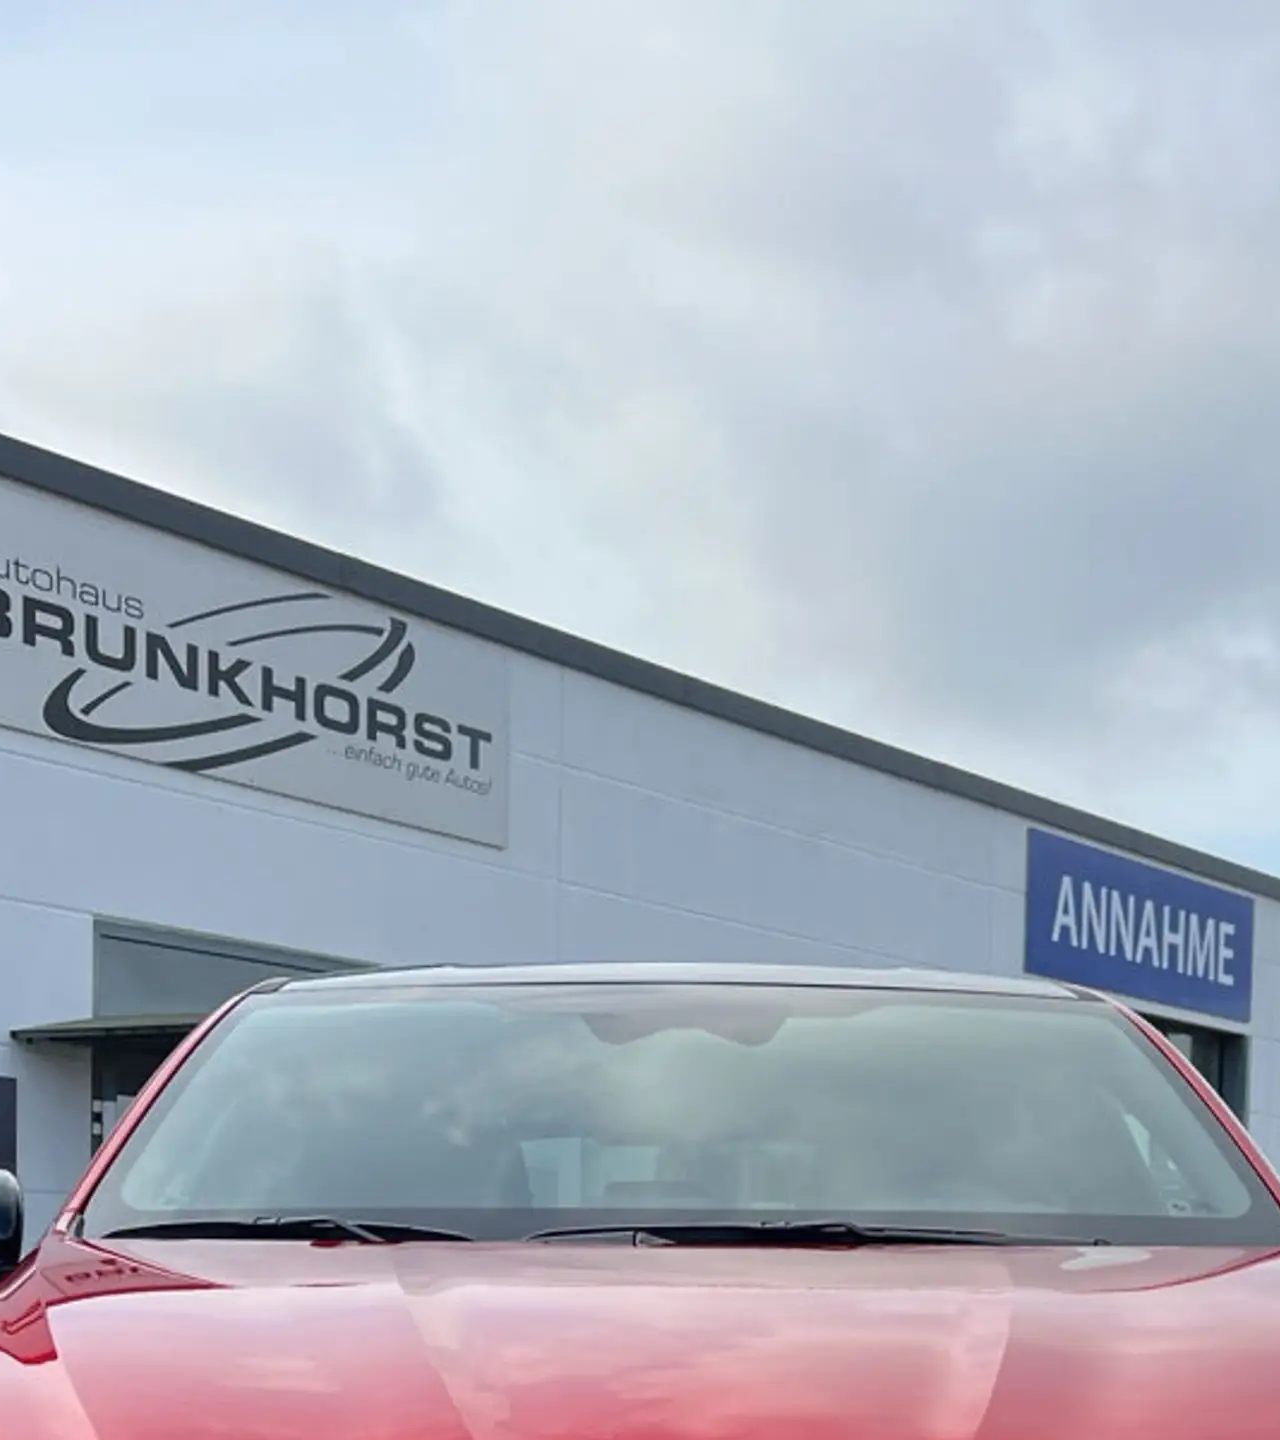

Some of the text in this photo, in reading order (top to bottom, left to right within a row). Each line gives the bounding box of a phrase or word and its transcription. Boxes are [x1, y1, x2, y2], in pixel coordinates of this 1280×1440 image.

[405, 760, 441, 783] gute
[445, 767, 493, 796] Autos!
[1051, 874, 1236, 987] ANNAHME
